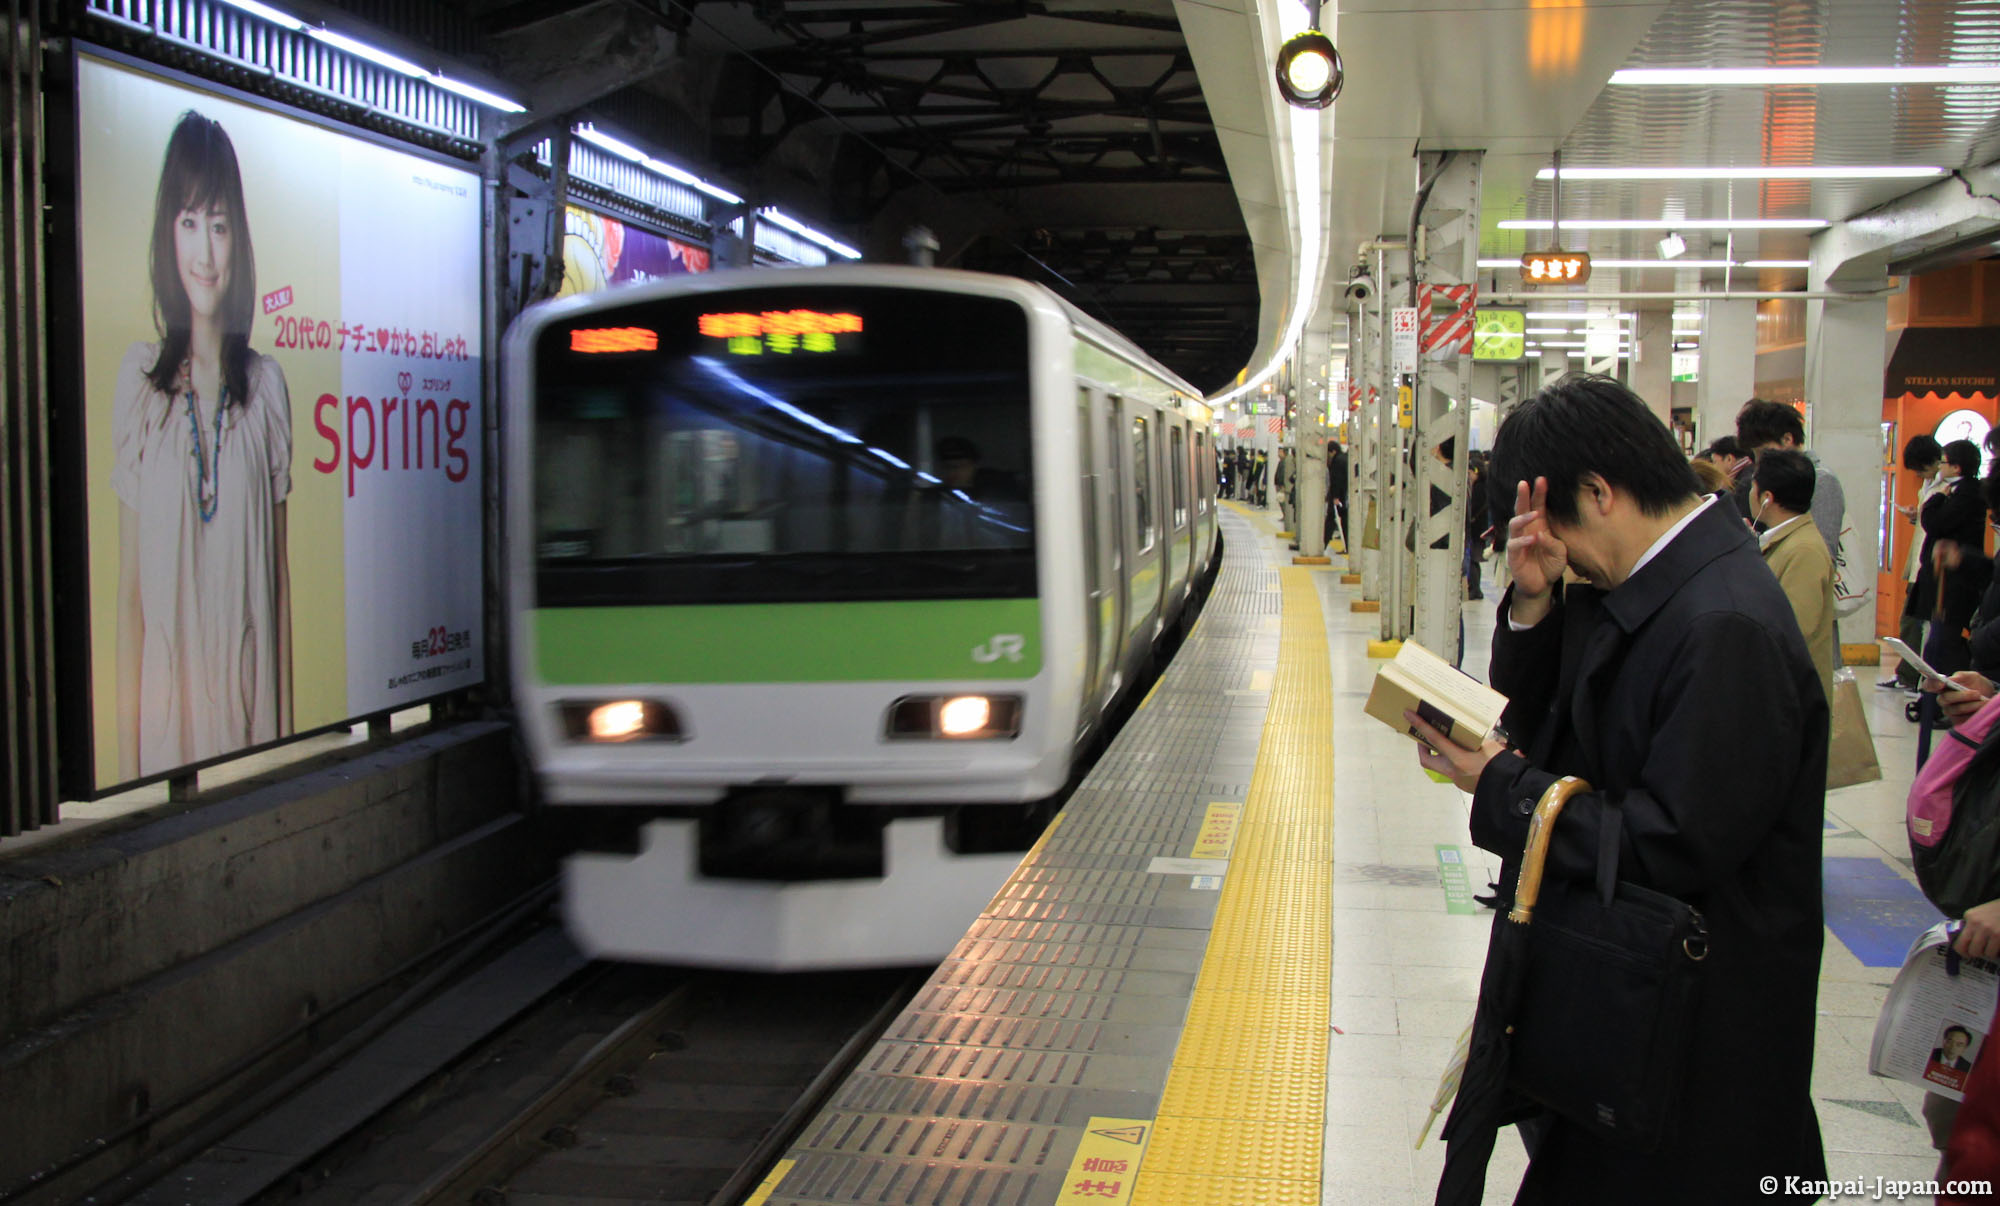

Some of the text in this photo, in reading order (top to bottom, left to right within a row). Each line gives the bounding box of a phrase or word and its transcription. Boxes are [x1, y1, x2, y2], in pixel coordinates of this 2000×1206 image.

[313, 371, 471, 498] spring
[970, 633, 1025, 664] JR
[1071, 1157, 1129, 1199] 注意
